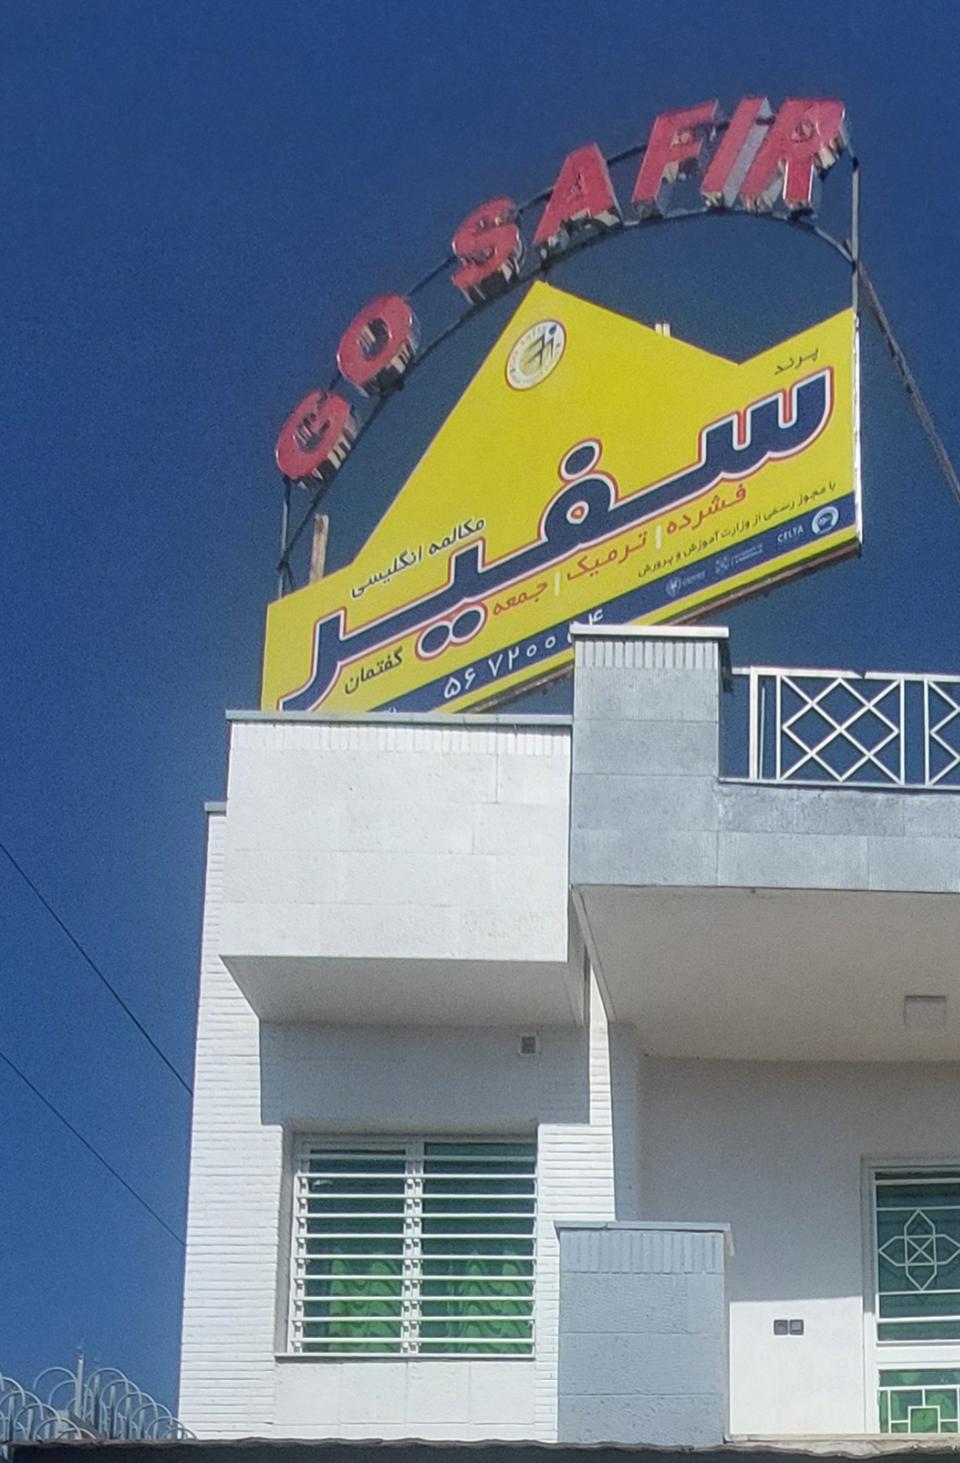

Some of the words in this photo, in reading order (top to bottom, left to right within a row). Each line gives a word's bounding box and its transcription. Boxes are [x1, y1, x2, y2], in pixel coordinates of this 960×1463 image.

[276, 292, 418, 481] GO
[452, 96, 848, 290] SAFIR
[667, 484, 746, 534] فشرده
[764, 501, 795, 521] رسمی
[798, 486, 826, 507] مجوز
[721, 519, 750, 537] وزارت
[752, 512, 761, 527] از
[777, 525, 804, 543] CELTA
[278, 366, 835, 711] سفیر
[428, 518, 485, 556] مکالمه
[683, 530, 719, 557] آموزش
[351, 544, 422, 599] انگلیسی
[567, 531, 647, 580] ترمیک
[638, 556, 674, 578] پرورش
[493, 582, 547, 616] جمعه
[344, 645, 403, 695] گفتمان
